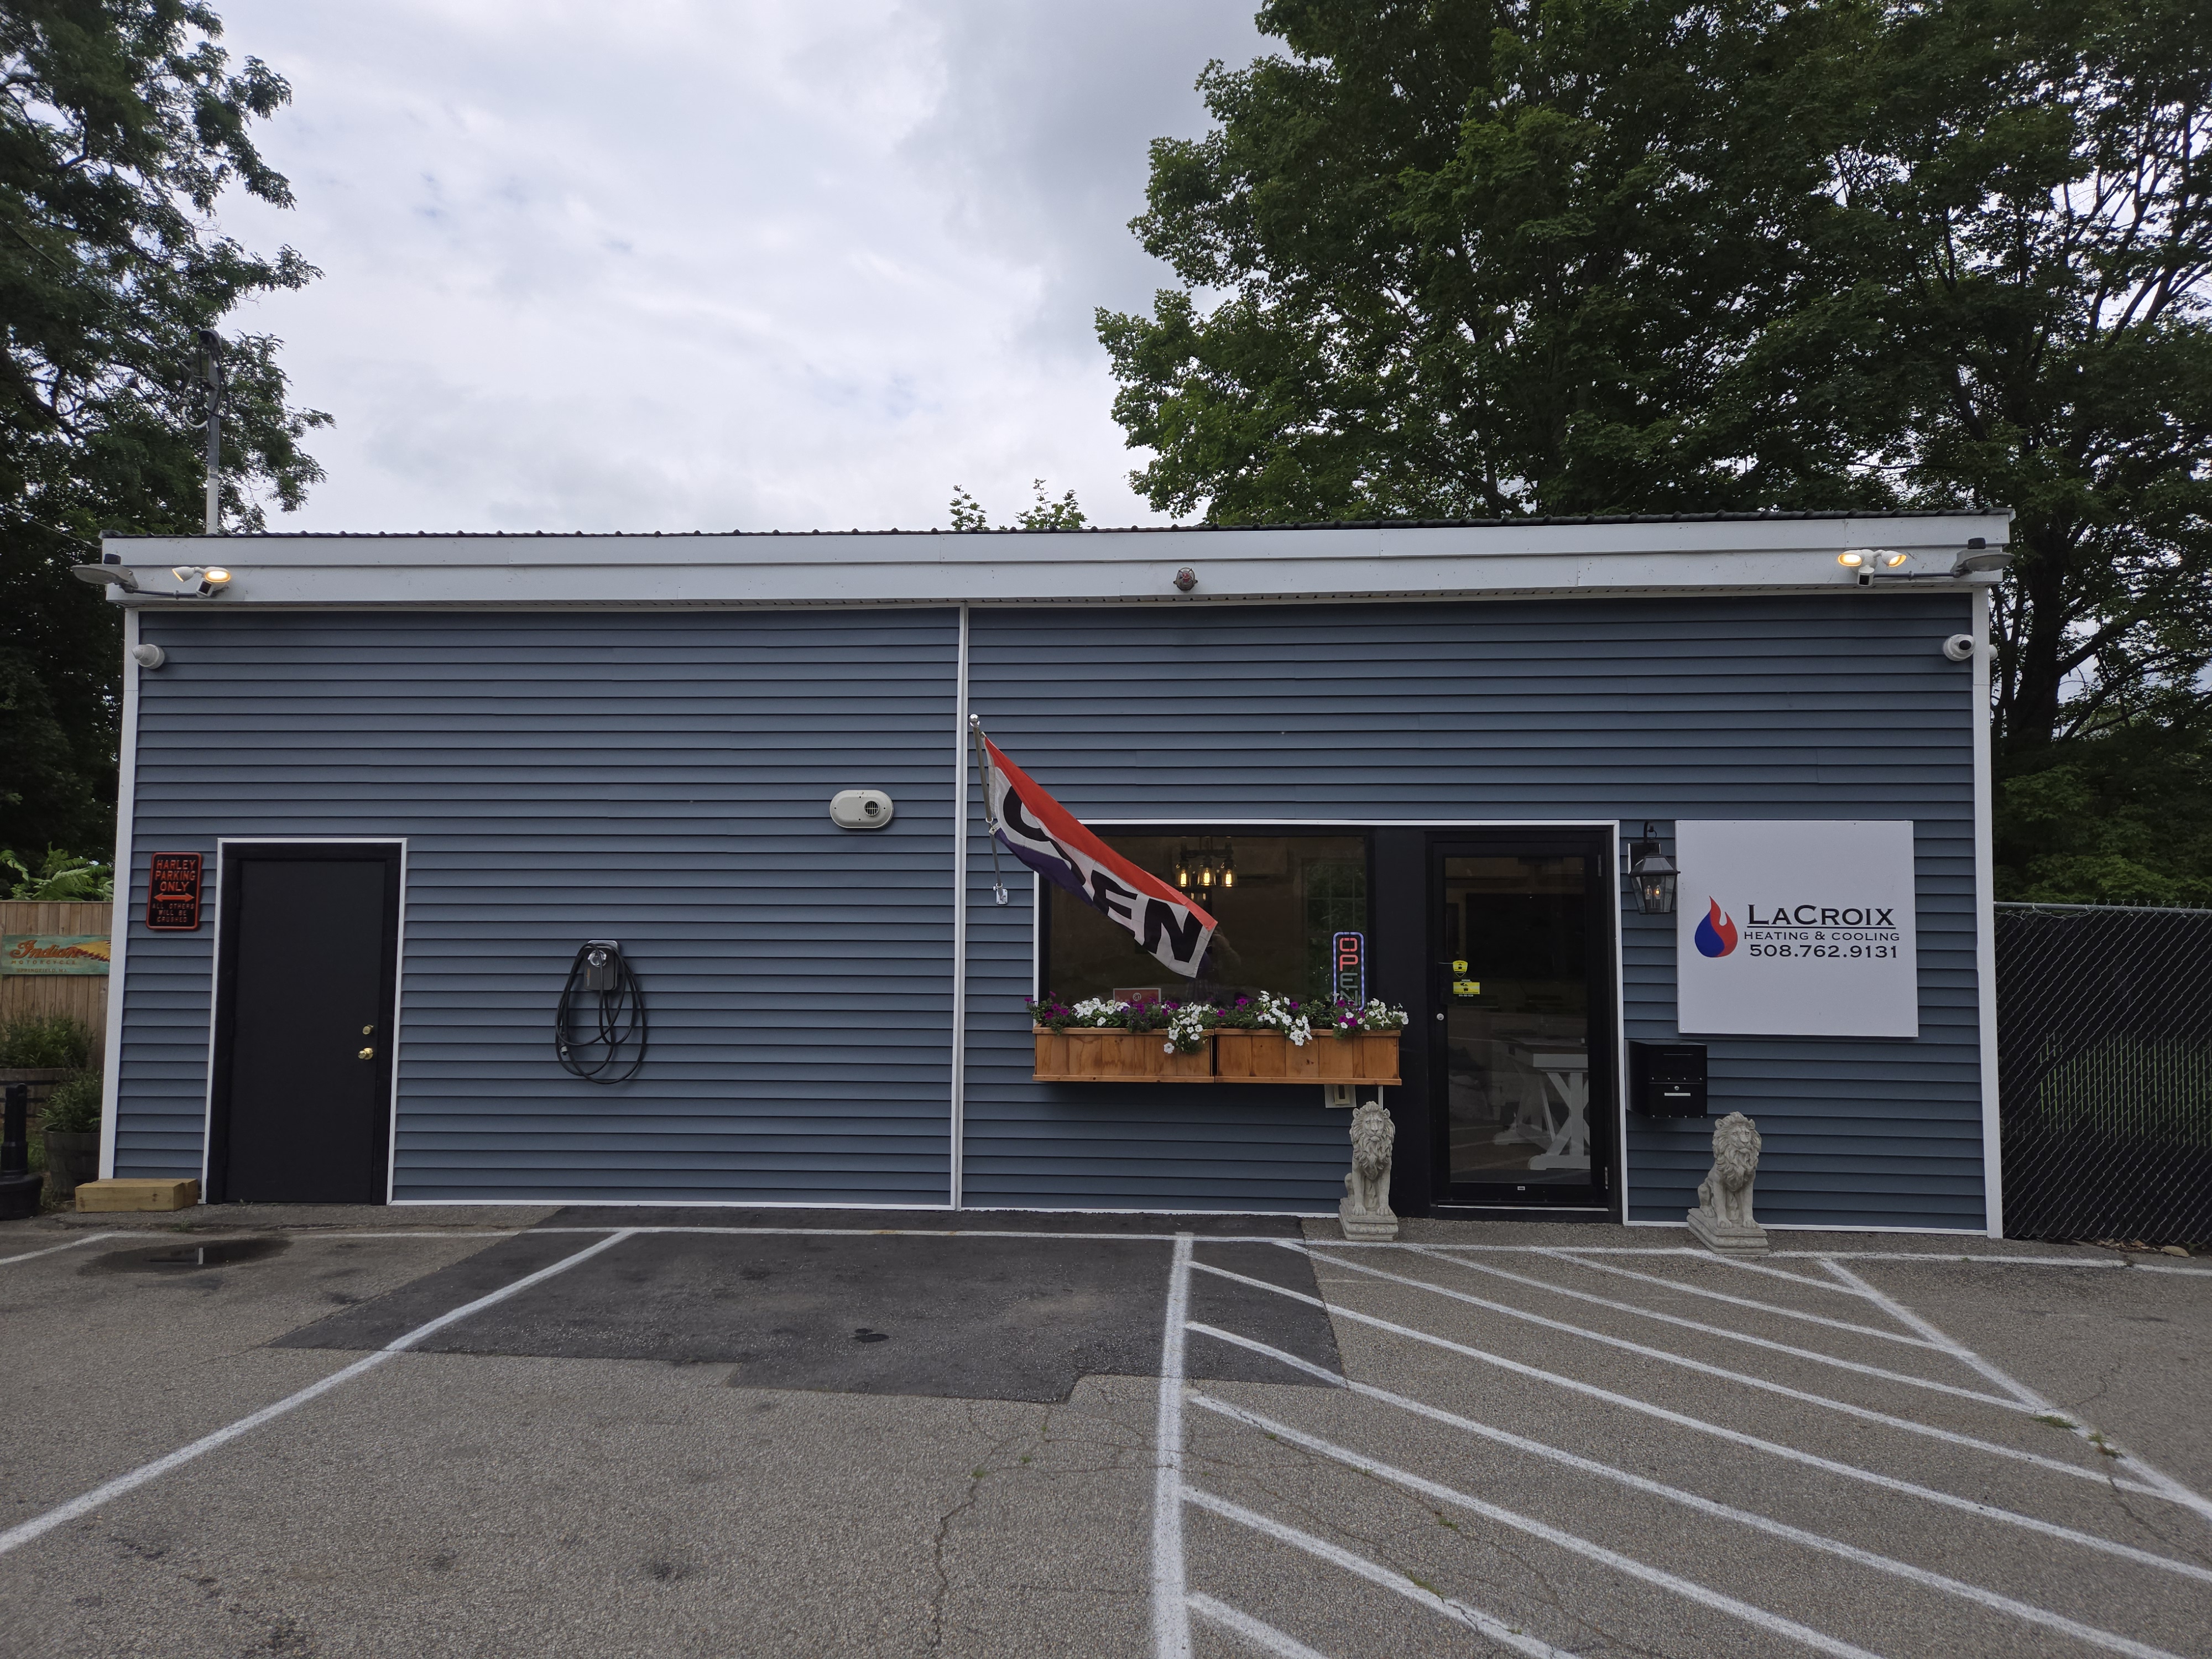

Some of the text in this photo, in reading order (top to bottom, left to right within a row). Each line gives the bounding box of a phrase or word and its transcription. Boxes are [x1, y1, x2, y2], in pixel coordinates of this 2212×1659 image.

[156, 859, 196, 869] HARLEY
[155, 870, 196, 881] PARKING
[160, 881, 190, 891] ONLY
[1744, 931, 1900, 941] HEATING & COOLING
[9, 940, 79, 959] Indian
[1750, 944, 1897, 958] 508.762.9131
[1339, 937, 1358, 1006] OPEN
